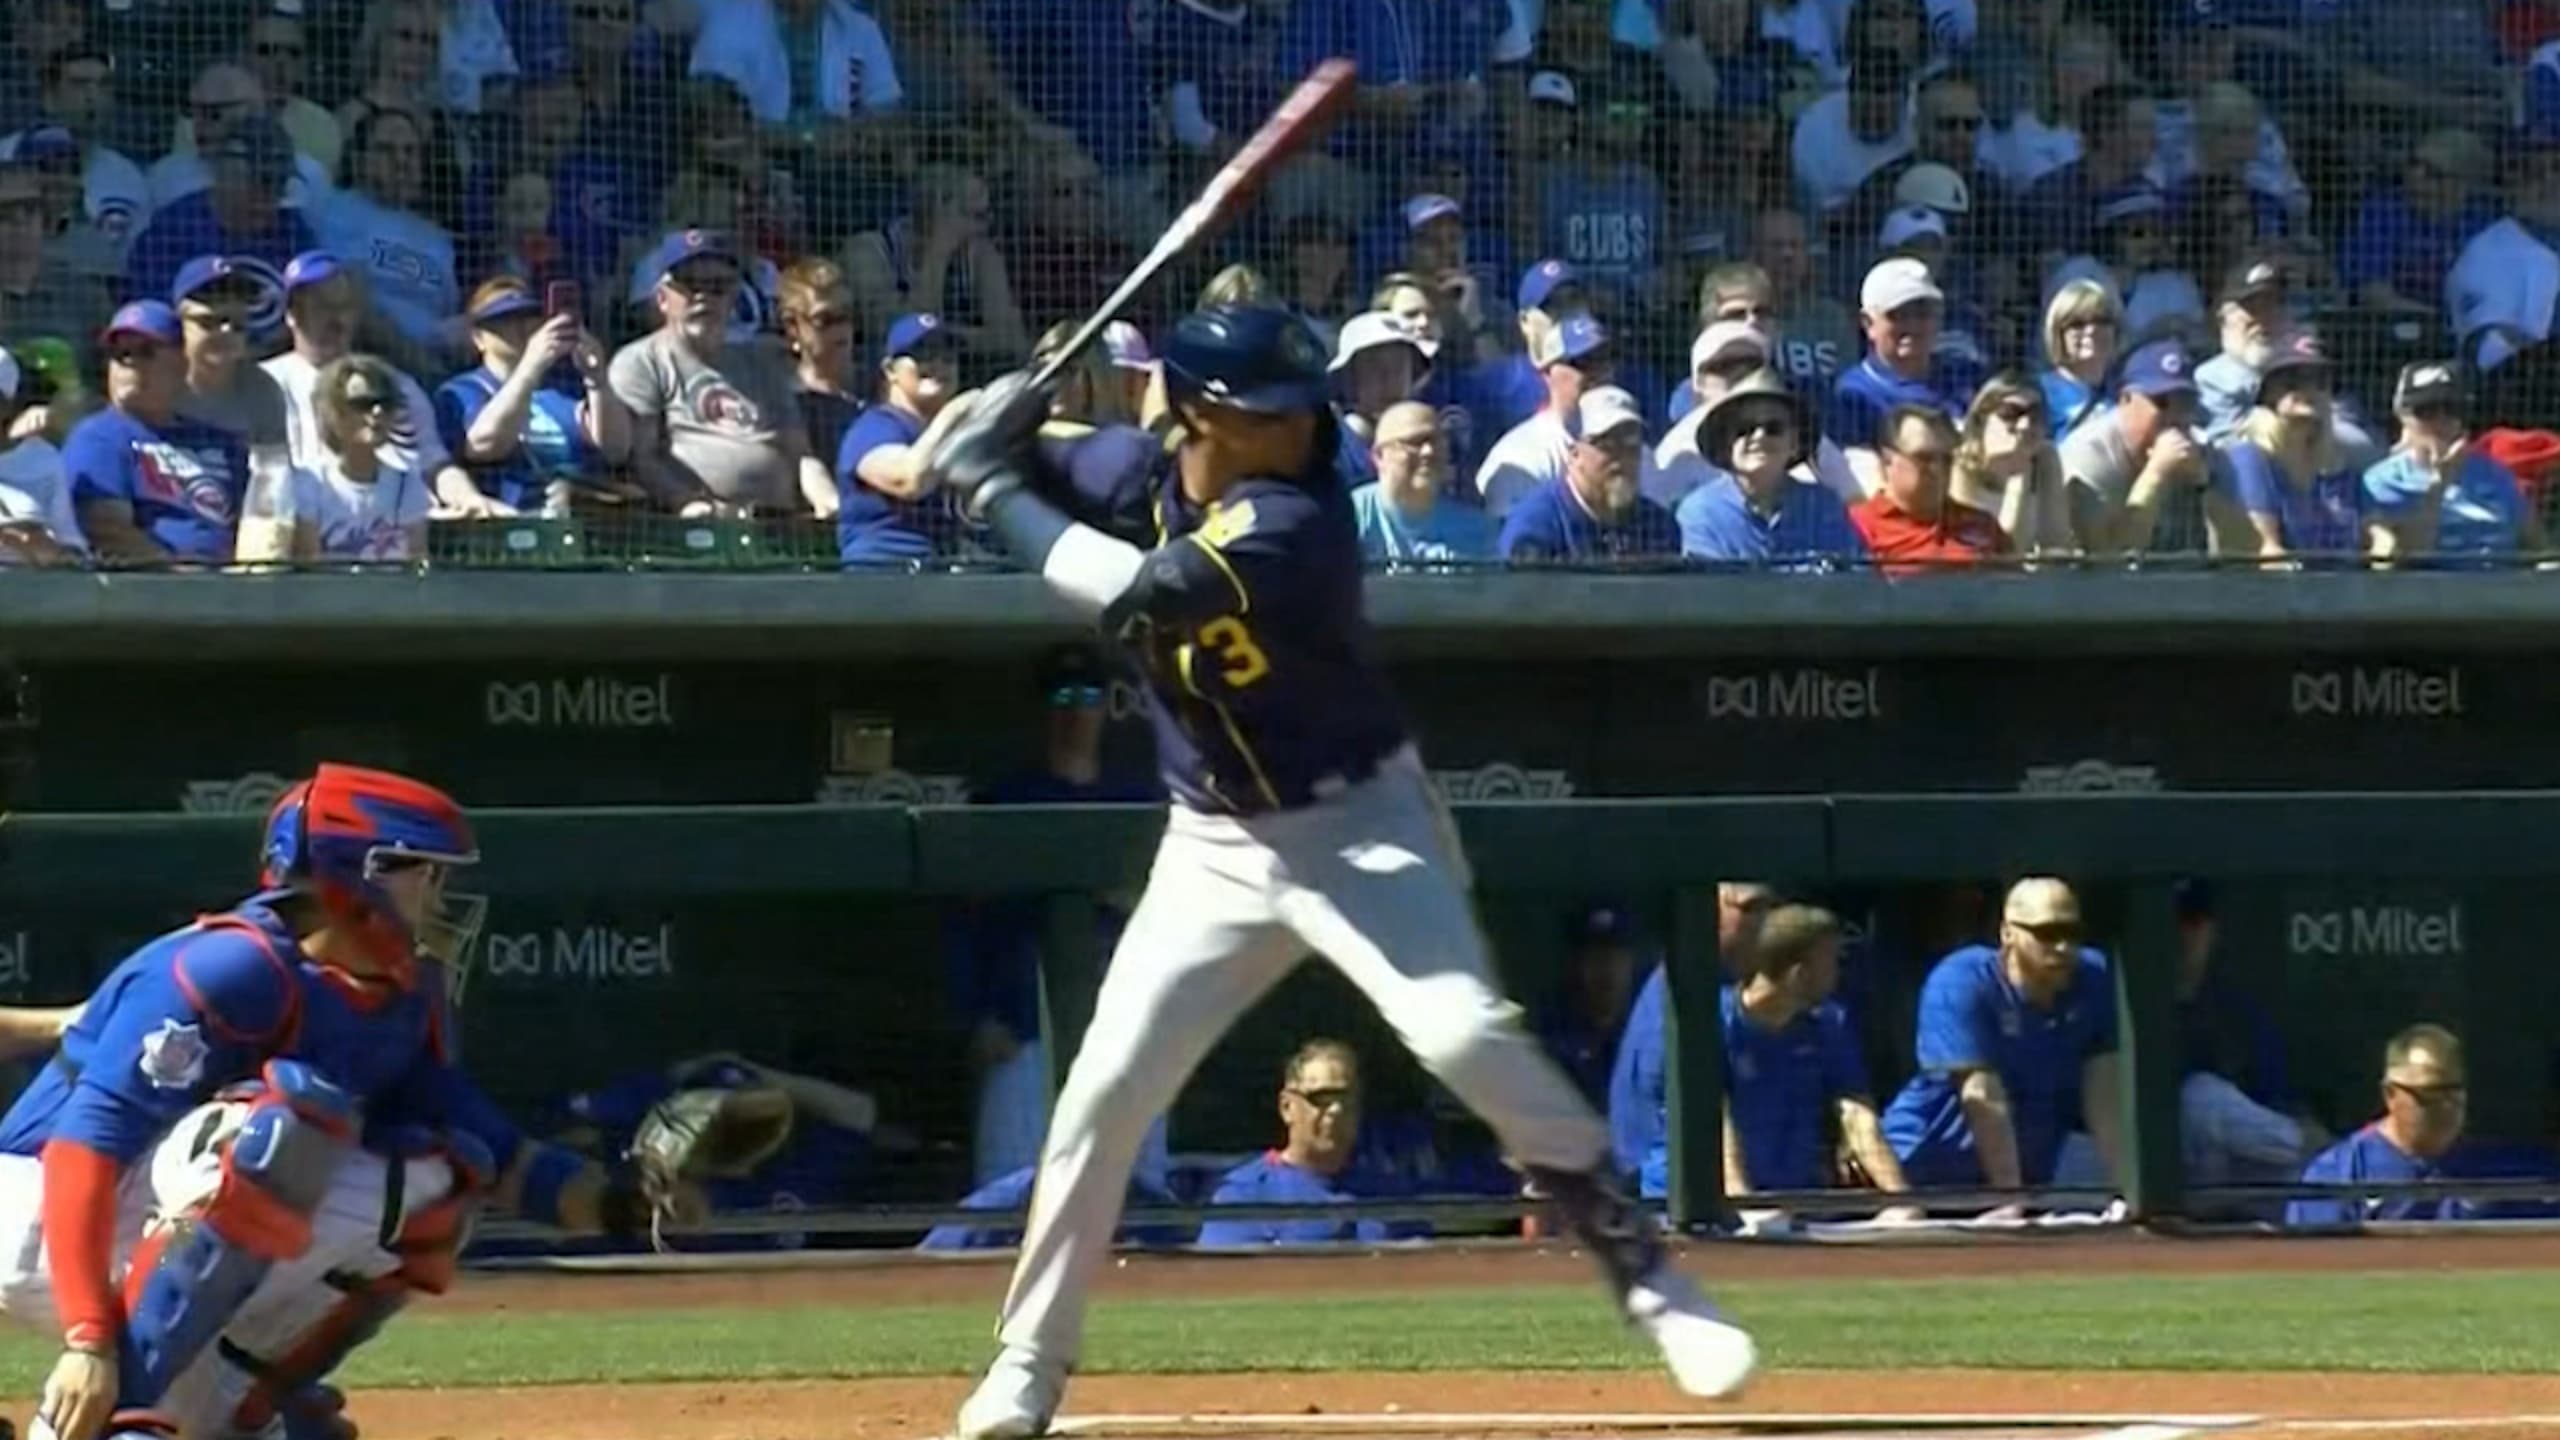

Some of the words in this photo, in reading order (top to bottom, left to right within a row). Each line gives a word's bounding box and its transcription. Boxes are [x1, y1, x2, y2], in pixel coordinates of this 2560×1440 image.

[1569, 213, 1646, 260] CUBS
[1199, 615, 1269, 687] 3
[552, 673, 672, 726] Mitel
[1768, 666, 1881, 719] Mitel
[2351, 665, 2464, 717] Mitel
[552, 923, 672, 975] Mitel
[2350, 906, 2464, 955] Mitel
